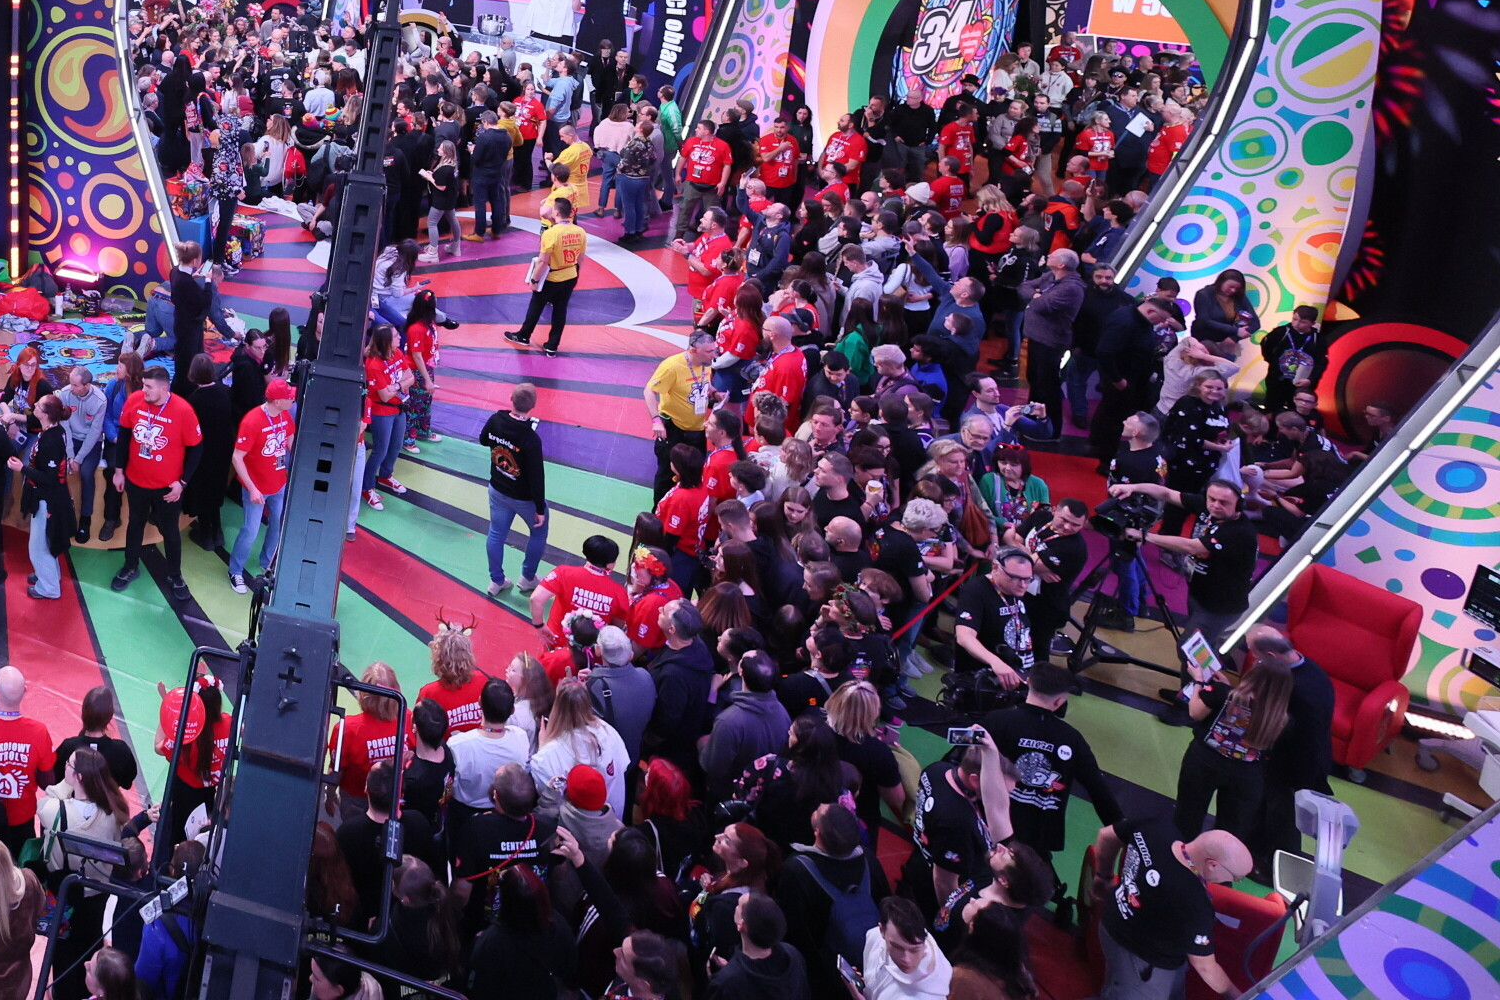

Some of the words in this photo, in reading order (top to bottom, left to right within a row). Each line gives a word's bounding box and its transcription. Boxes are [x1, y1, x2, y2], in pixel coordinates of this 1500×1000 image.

[656, 20, 685, 77] obiad
[572, 594, 604, 610] PATROL
[573, 586, 614, 605] POKOJOWY
[366, 733, 409, 750] POKOJOY
[368, 745, 397, 759] PATRO
